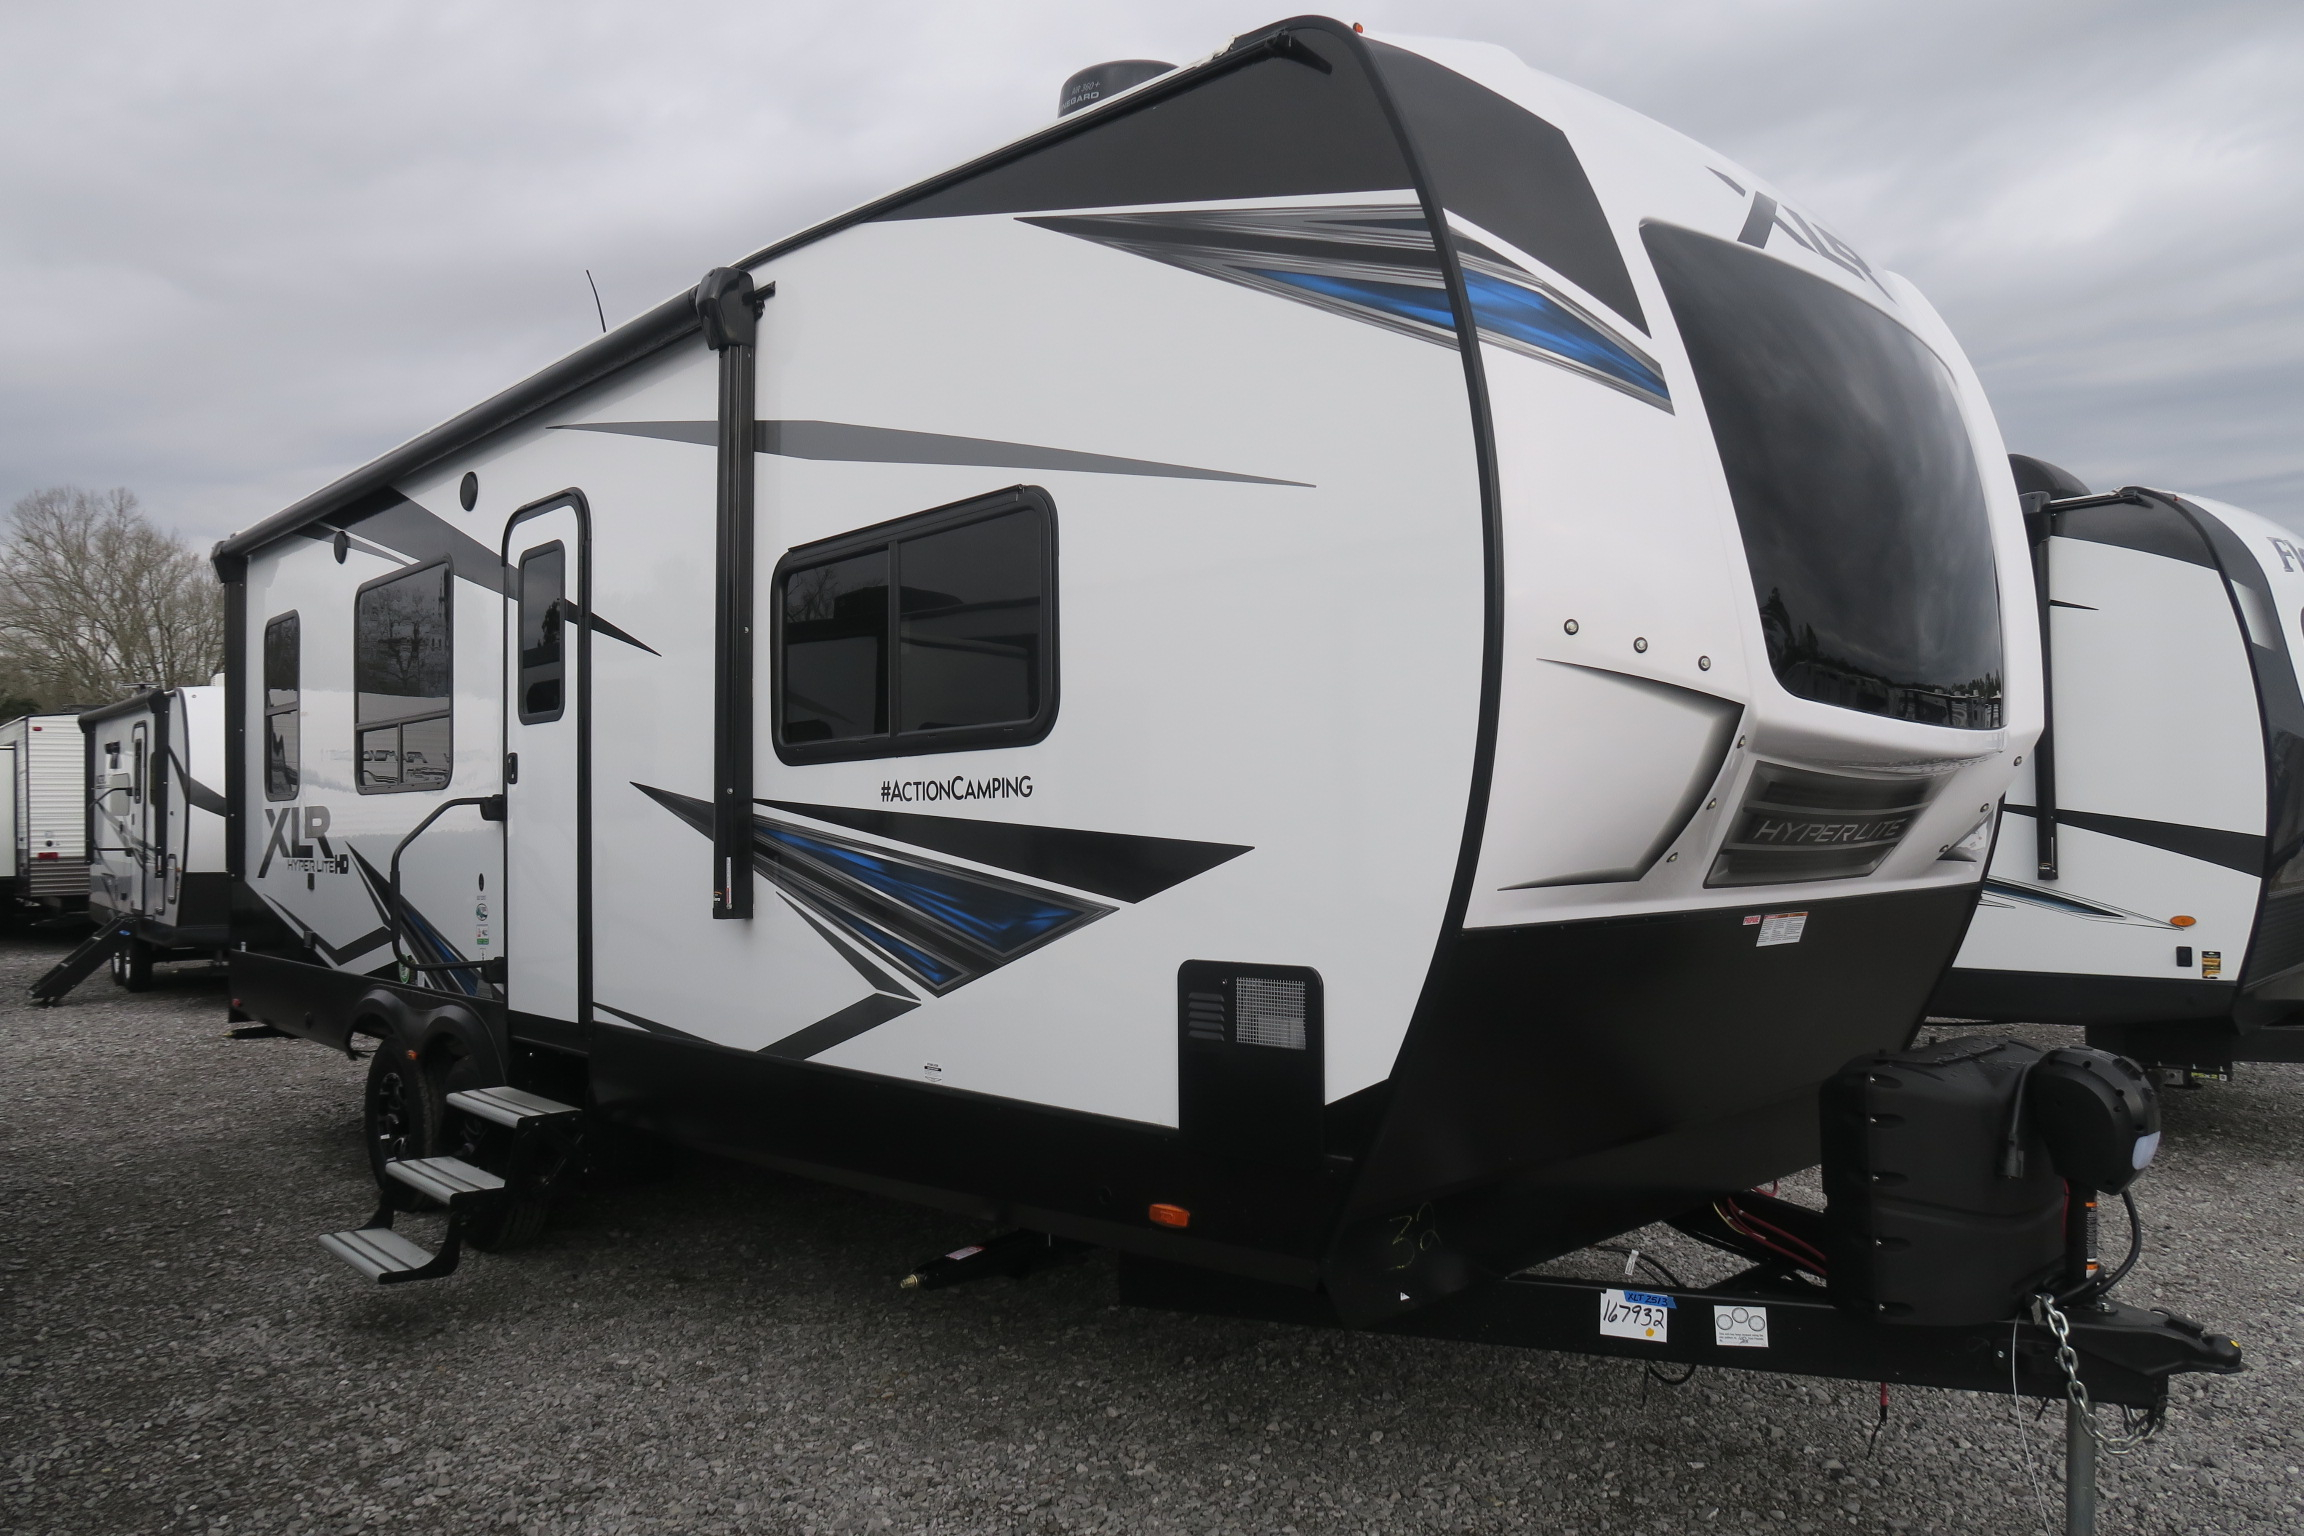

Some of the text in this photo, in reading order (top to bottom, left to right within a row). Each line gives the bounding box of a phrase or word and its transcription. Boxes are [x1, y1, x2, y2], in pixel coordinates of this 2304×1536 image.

[257, 805, 334, 878] XLR
[1603, 1299, 1665, 1329] 167932
[1627, 1293, 1668, 1307] XLT 2513
